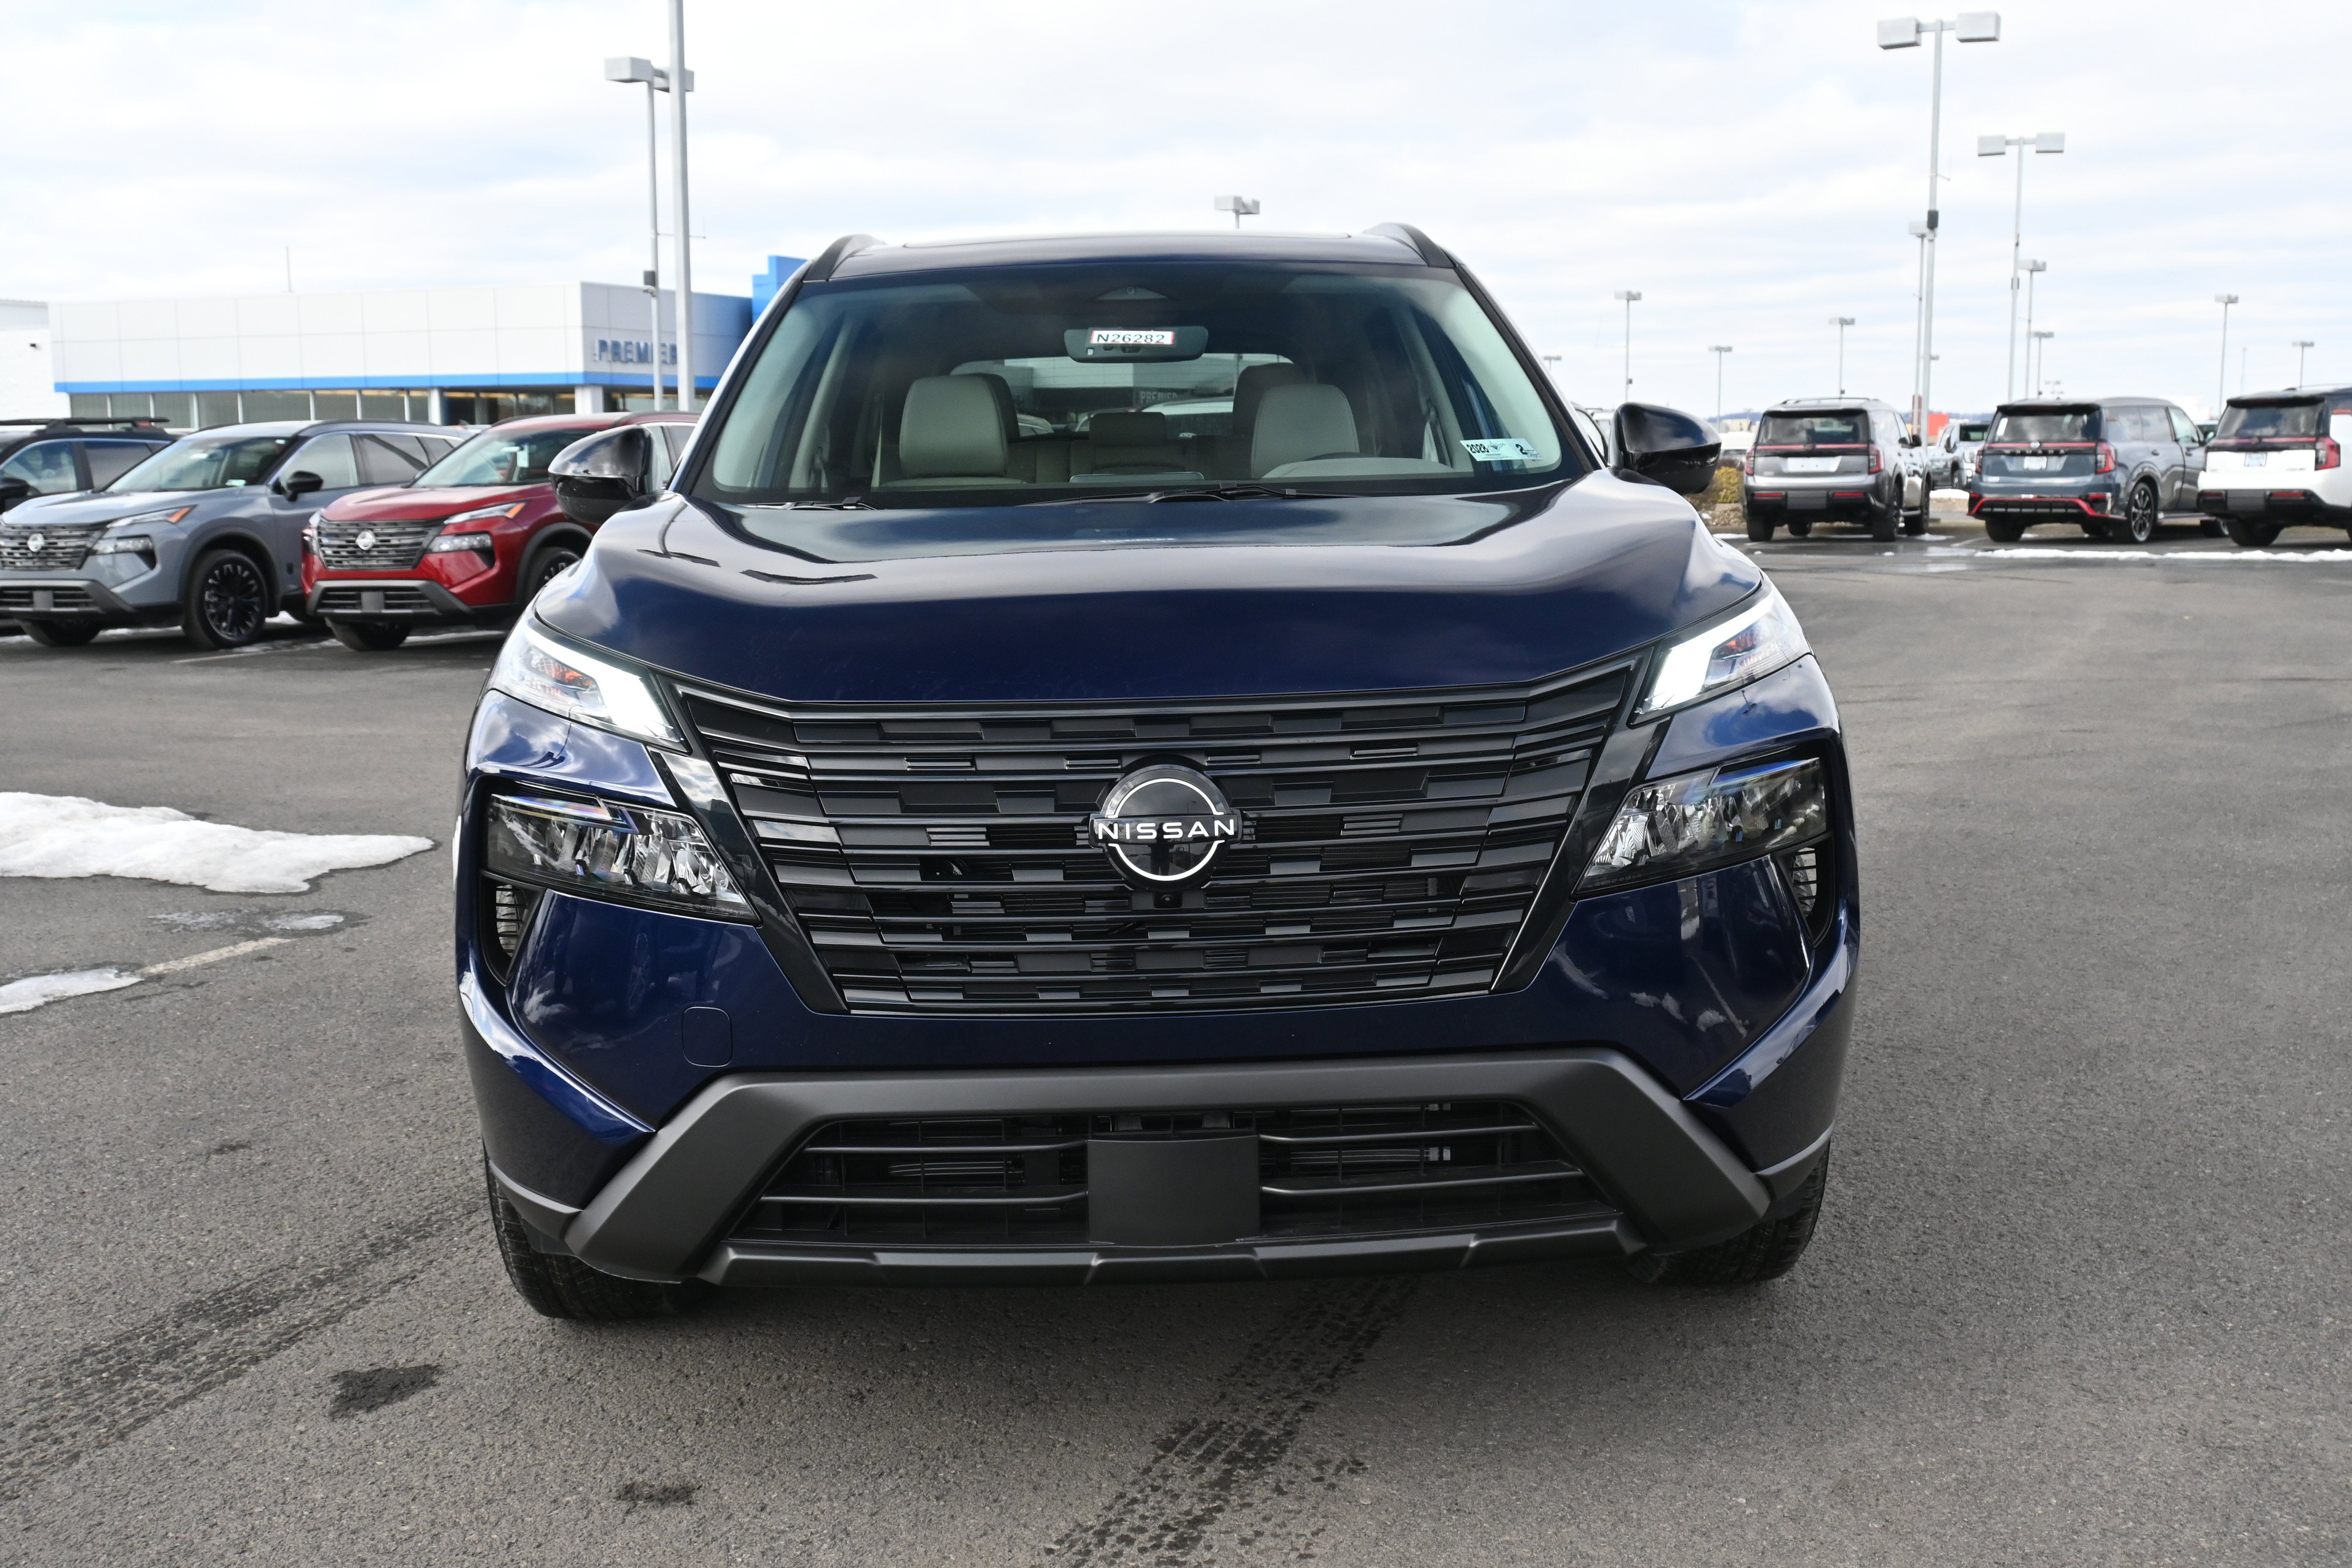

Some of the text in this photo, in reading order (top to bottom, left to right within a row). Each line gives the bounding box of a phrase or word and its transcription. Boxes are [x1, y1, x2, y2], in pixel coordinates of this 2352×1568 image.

[1097, 334, 1165, 343] N26282
[1466, 444, 1528, 455] 2028 2
[1098, 819, 1234, 839] NISSAN
